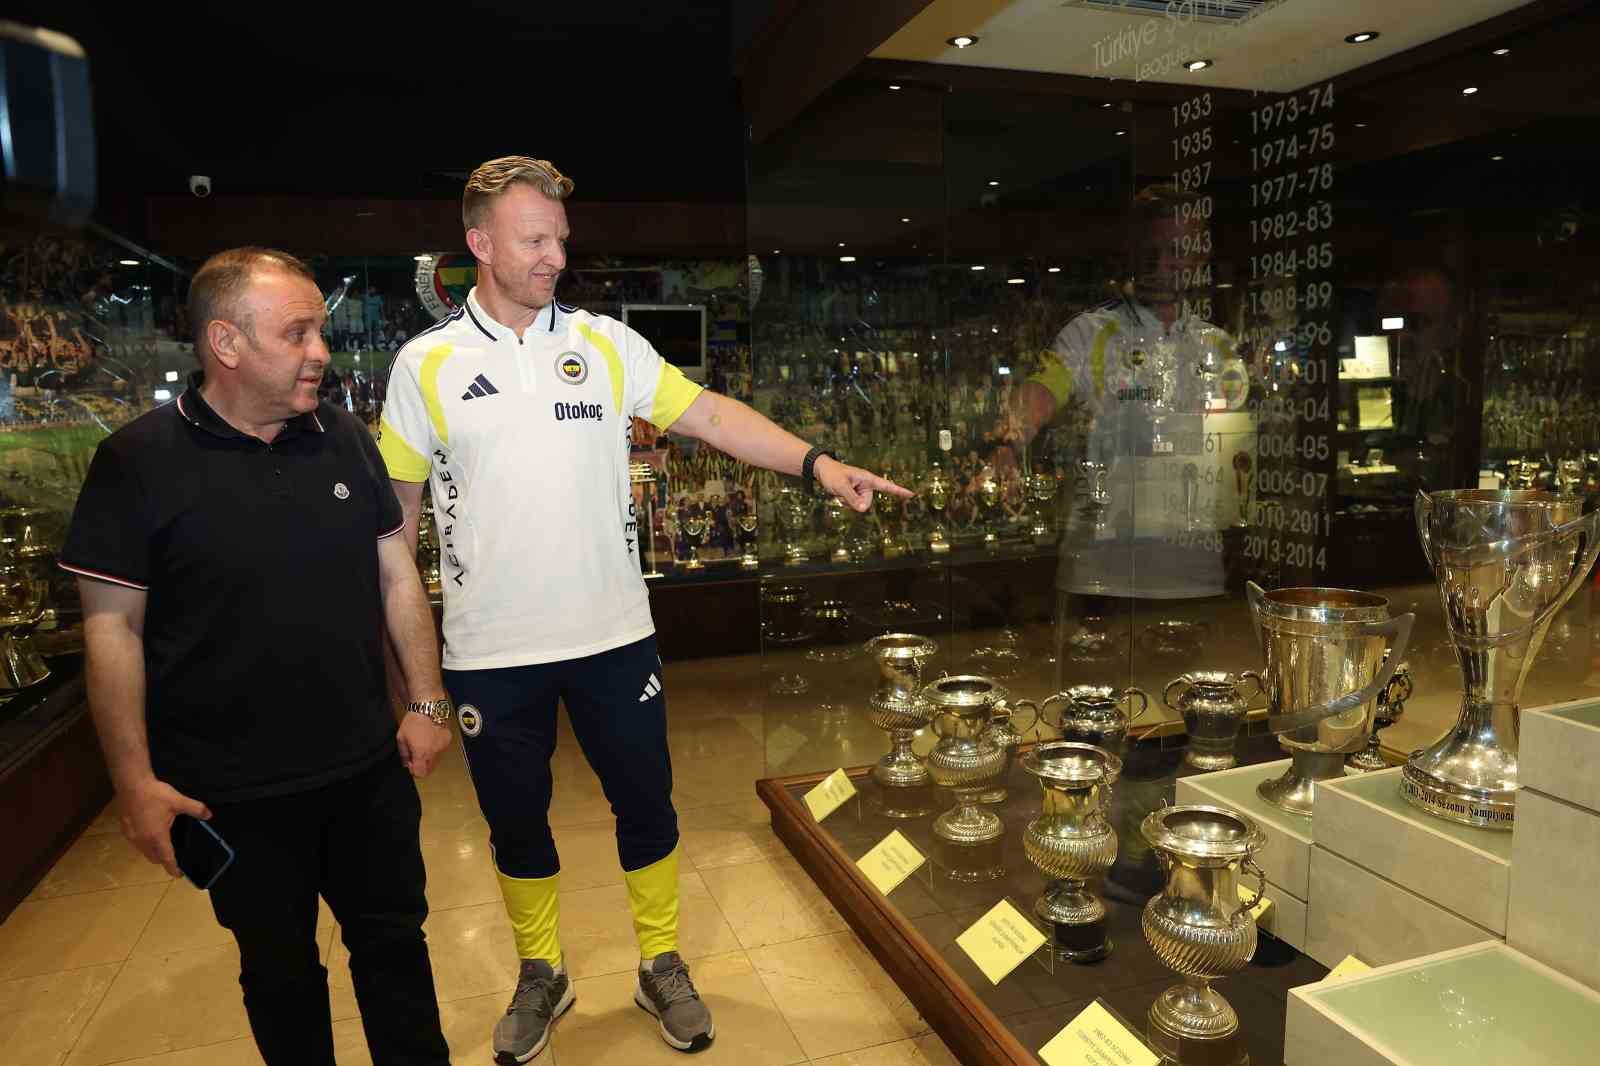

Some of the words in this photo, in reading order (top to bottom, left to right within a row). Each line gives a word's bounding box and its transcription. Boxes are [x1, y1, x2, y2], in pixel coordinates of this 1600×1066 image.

[1092, 19, 1159, 71] Türkiye
[1172, 93, 1212, 128] 1933
[1250, 83, 1334, 134] 1973-74
[1172, 127, 1212, 161] 1935
[1250, 122, 1335, 171] 1974-75
[1172, 161, 1212, 193] 1937
[1250, 163, 1333, 207] 1977-78
[1172, 197, 1213, 226] 1940
[1250, 203, 1333, 243] 1982-83
[1173, 230, 1212, 259] 1943
[1250, 242, 1333, 279] 1984-85
[1173, 264, 1212, 291] 1944
[1250, 281, 1333, 315] 1988-89
[554, 401, 603, 422] Otokoç
[1249, 434, 1330, 460] 004-05
[1248, 504, 1331, 537] 010-2011
[1243, 535, 1327, 571] 2013-2014
[1437, 798, 1466, 815] Sezonu
